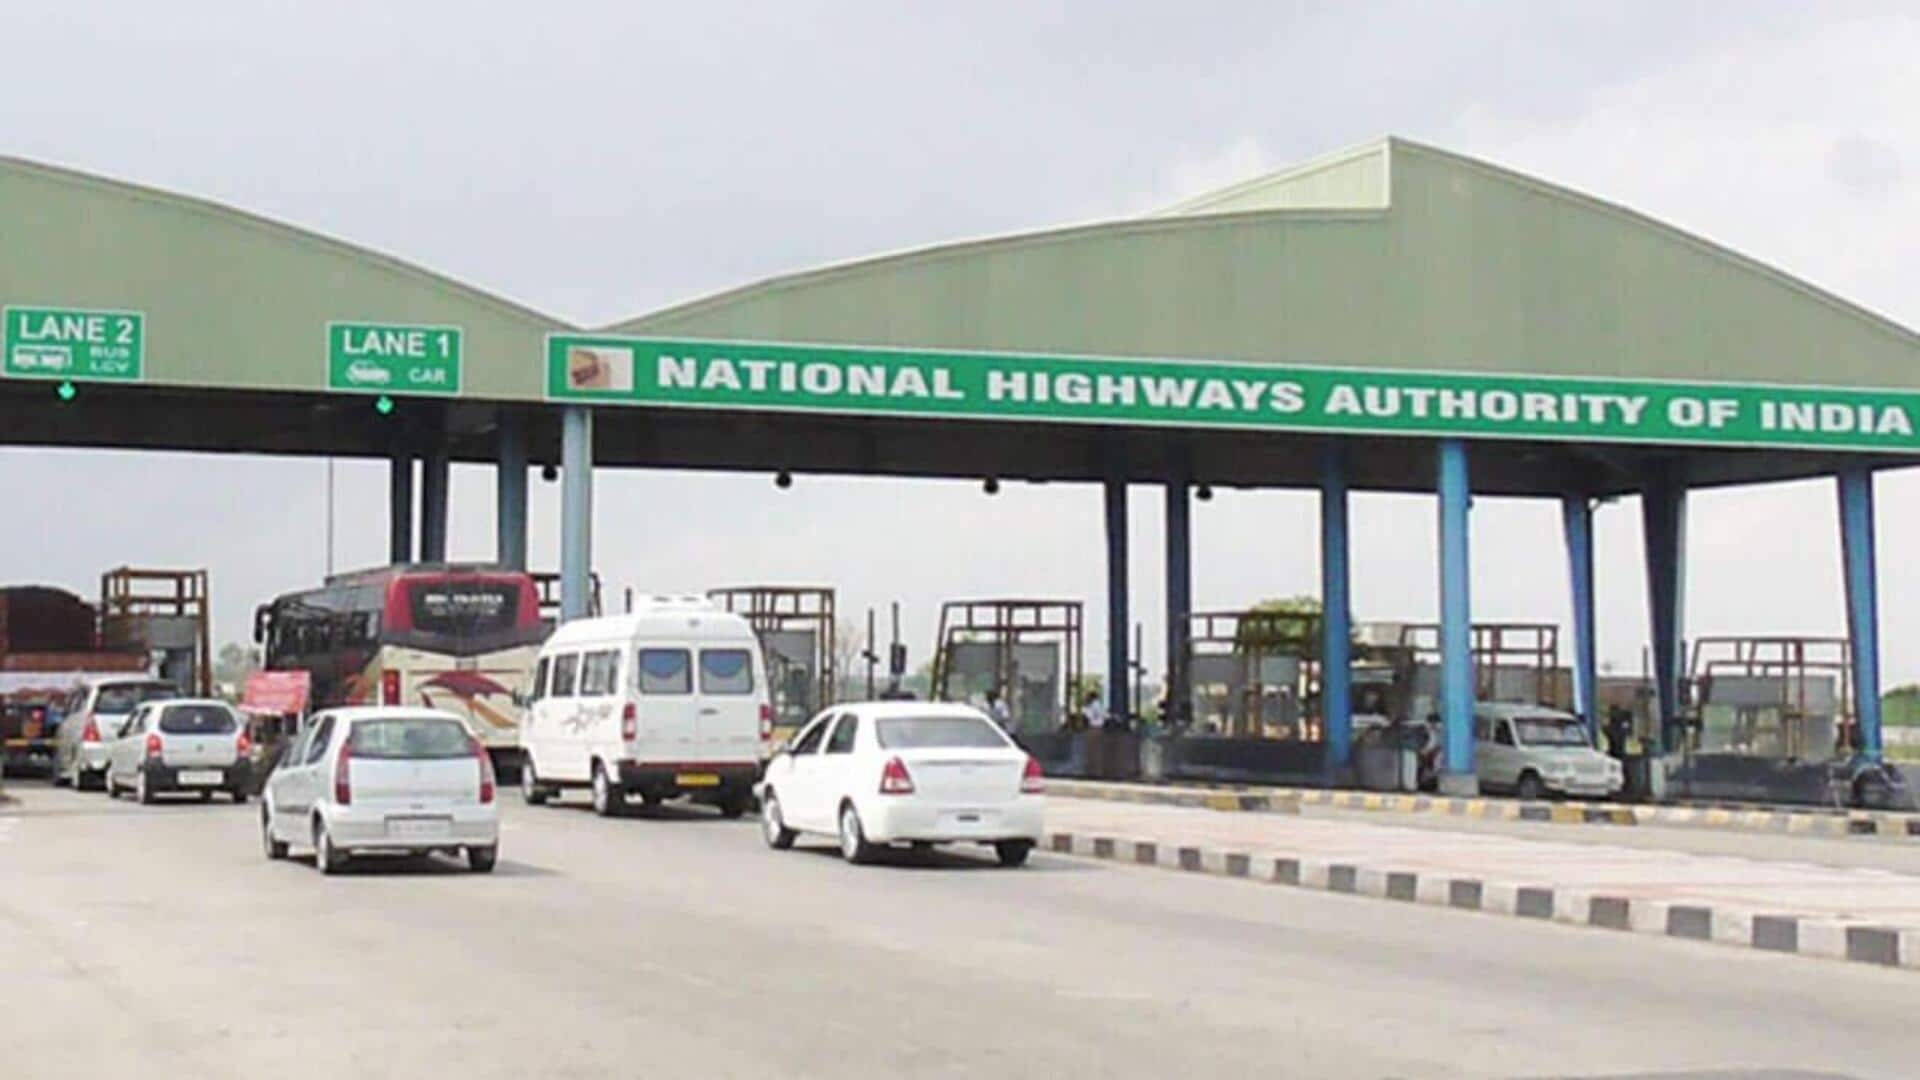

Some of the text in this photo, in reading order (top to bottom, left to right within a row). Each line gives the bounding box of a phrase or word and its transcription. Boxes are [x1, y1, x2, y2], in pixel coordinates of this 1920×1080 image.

[20, 313, 134, 344] LANE 2
[89, 346, 130, 359] BUS
[343, 329, 450, 358] LANE 1
[407, 366, 447, 385] CAR
[657, 355, 1913, 435] NATIONAL HIGHWAYS AUTHORITY OF INDIA
